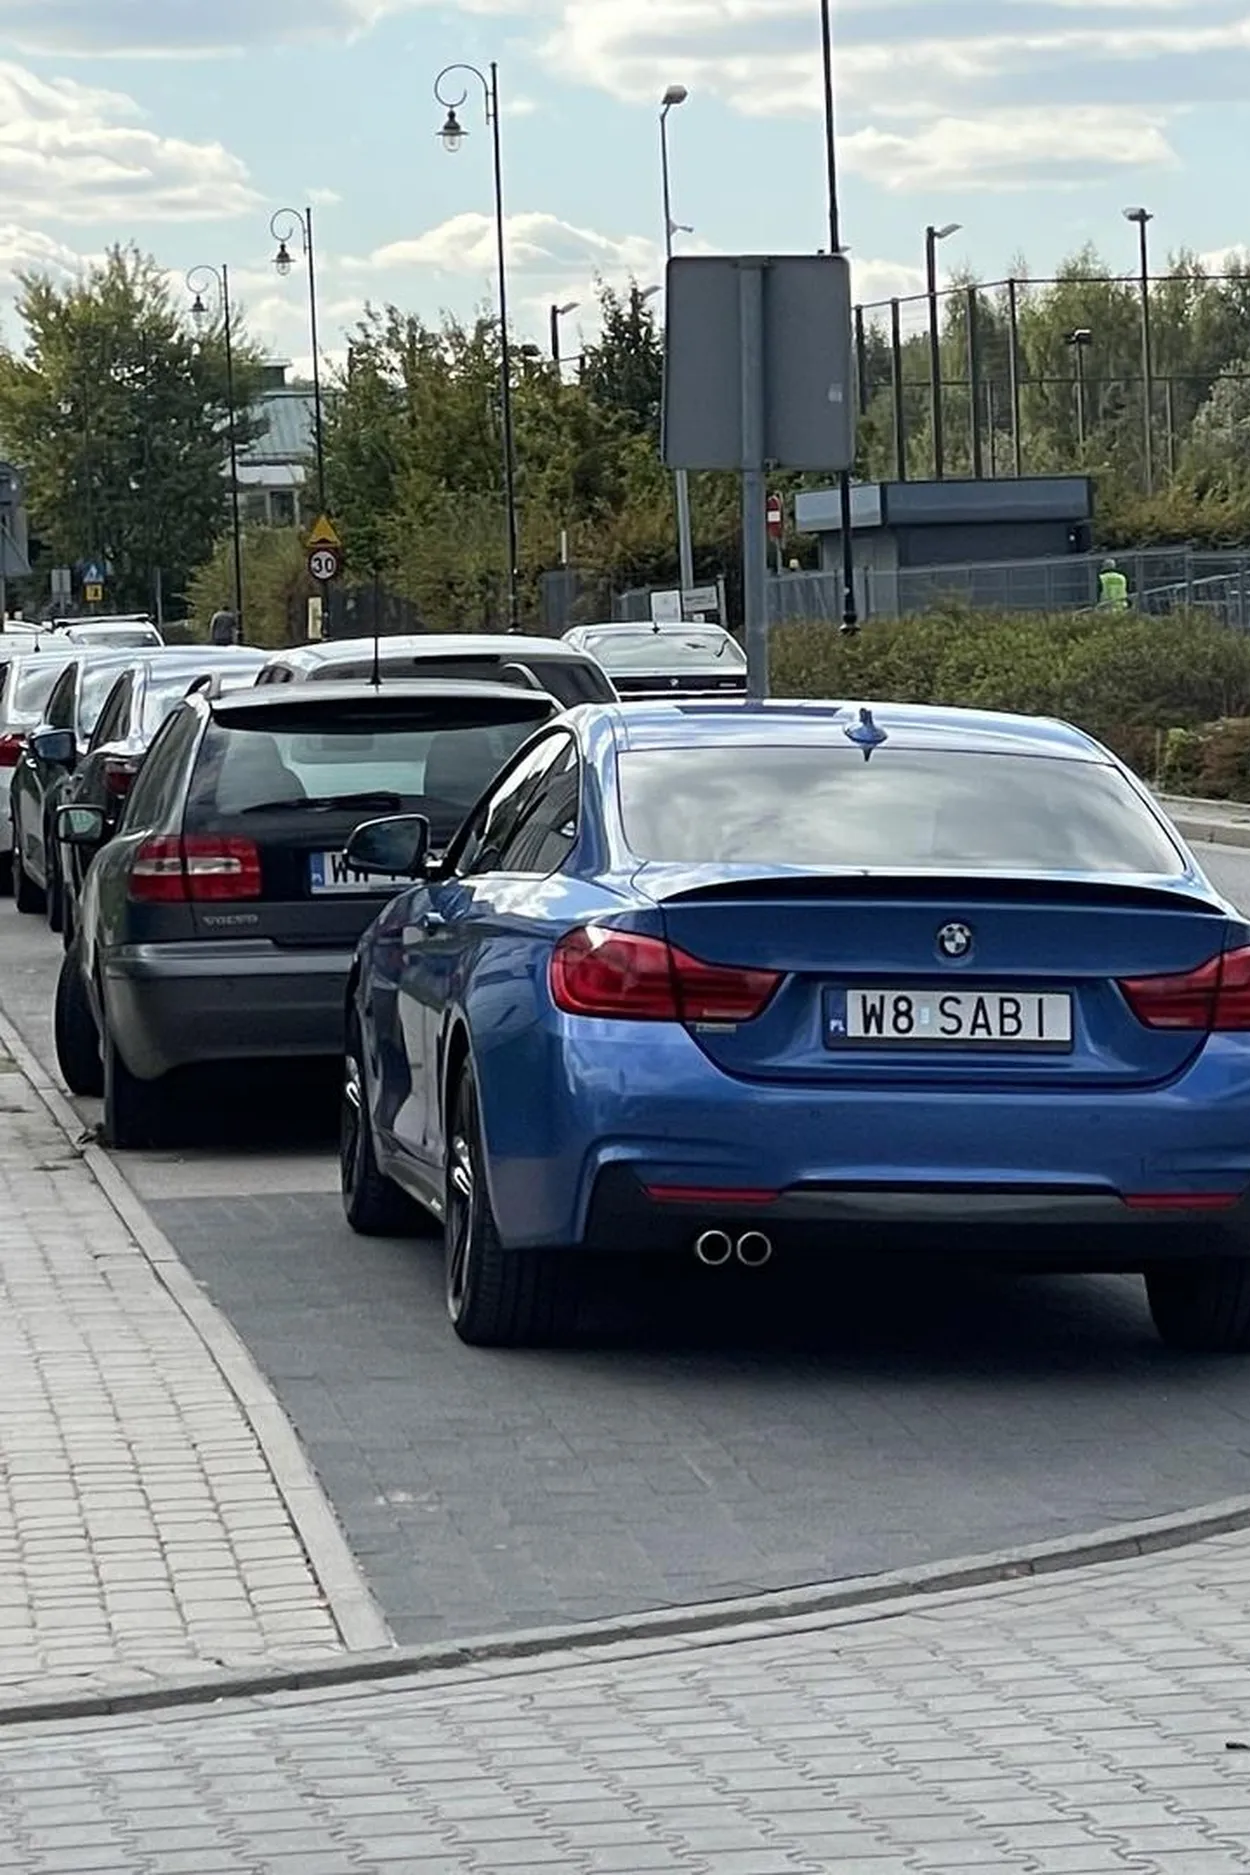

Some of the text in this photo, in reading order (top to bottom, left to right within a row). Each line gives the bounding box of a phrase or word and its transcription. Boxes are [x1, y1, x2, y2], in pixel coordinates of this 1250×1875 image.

[313, 557, 334, 574] 30
[861, 994, 1044, 1038] W8 SABI
